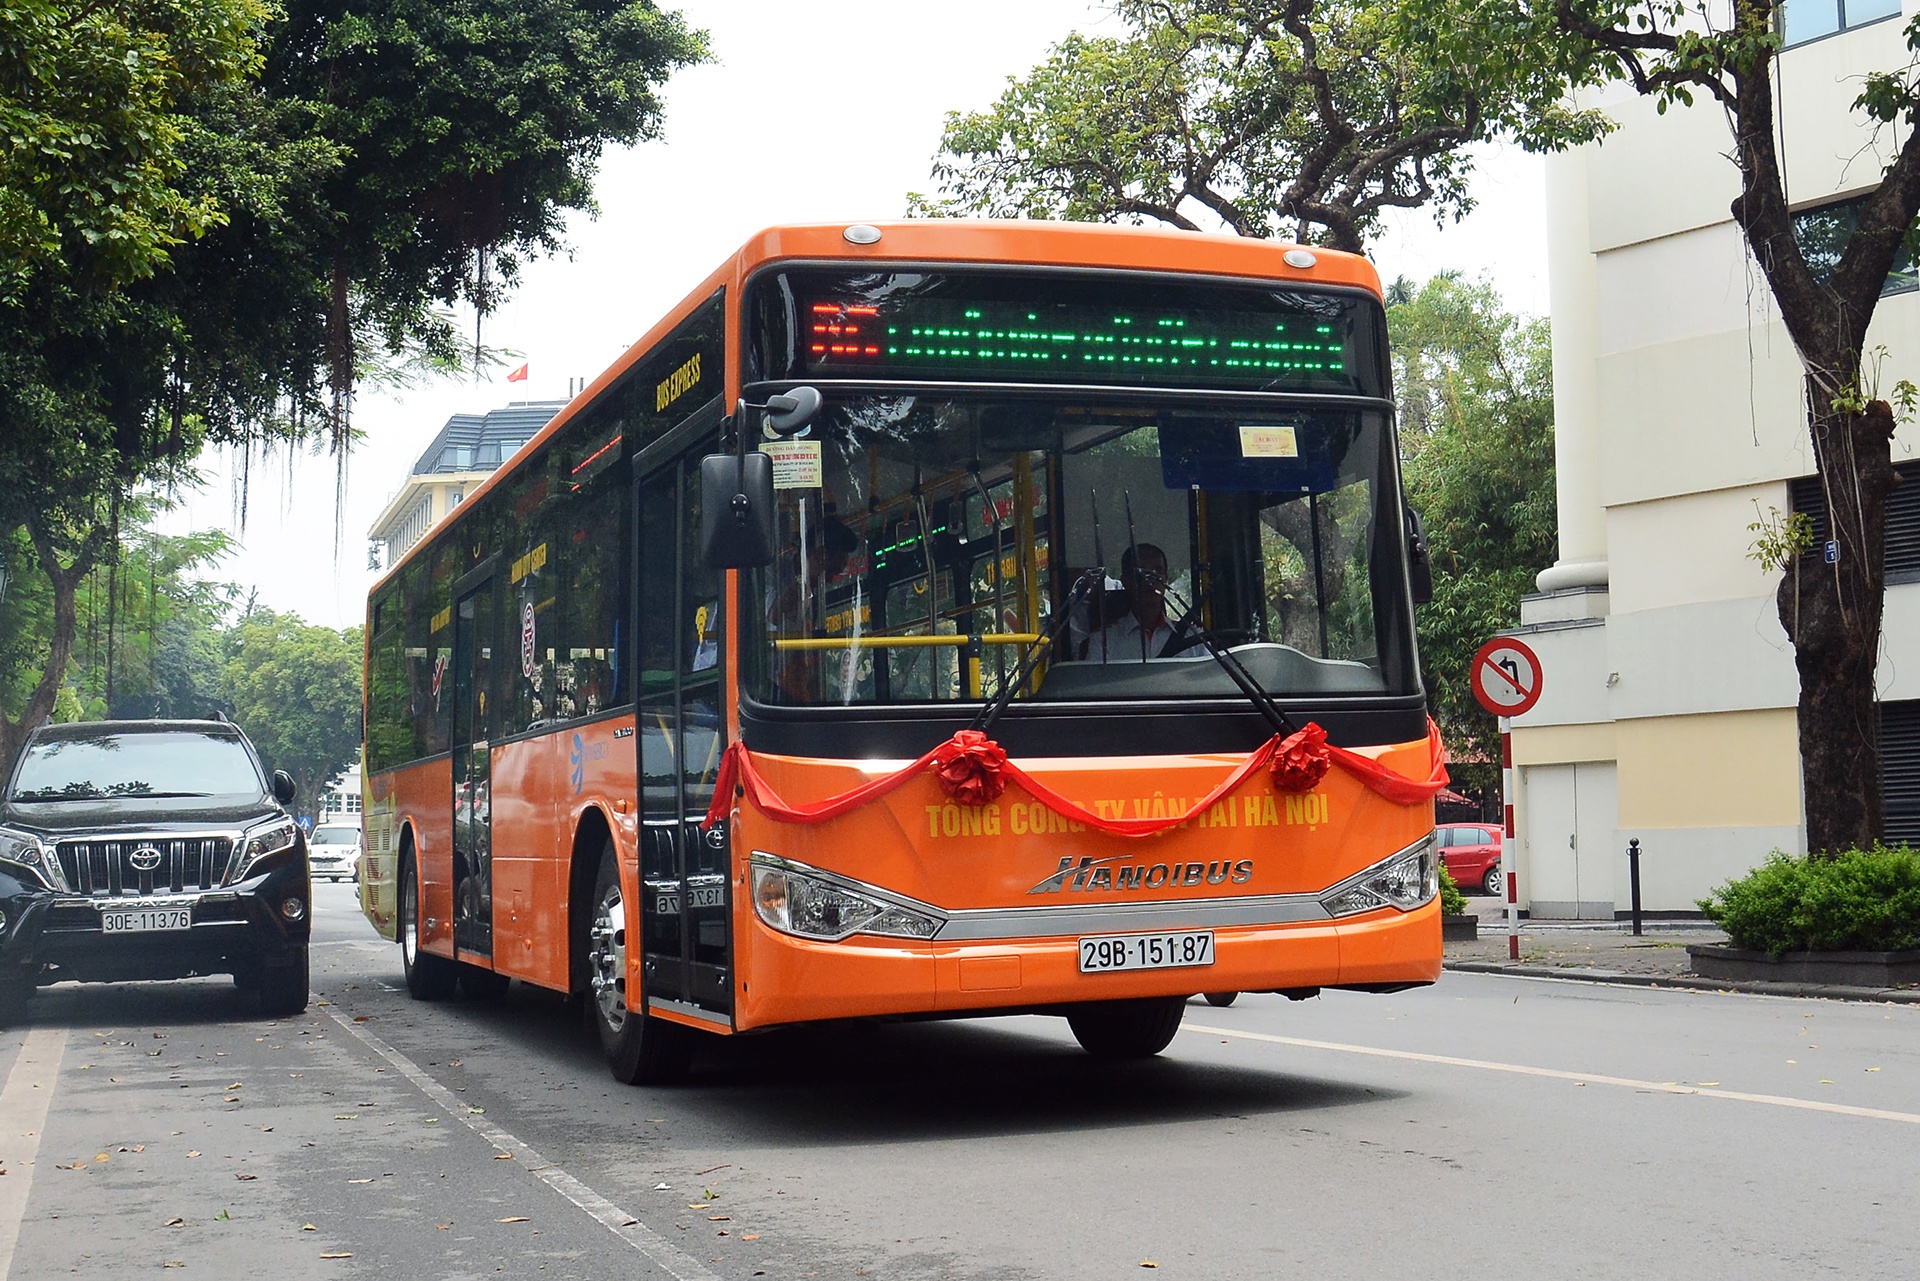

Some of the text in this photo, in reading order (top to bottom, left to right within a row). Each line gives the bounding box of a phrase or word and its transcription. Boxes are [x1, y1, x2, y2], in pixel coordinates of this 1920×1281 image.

[657, 352, 701, 413] BUS EXPRESS
[1244, 787, 1279, 827] HÀ
[1026, 855, 1253, 894] HANOIBUS
[105, 911, 189, 931] 30E-113.76
[1082, 934, 1210, 969] 29B-151.87
